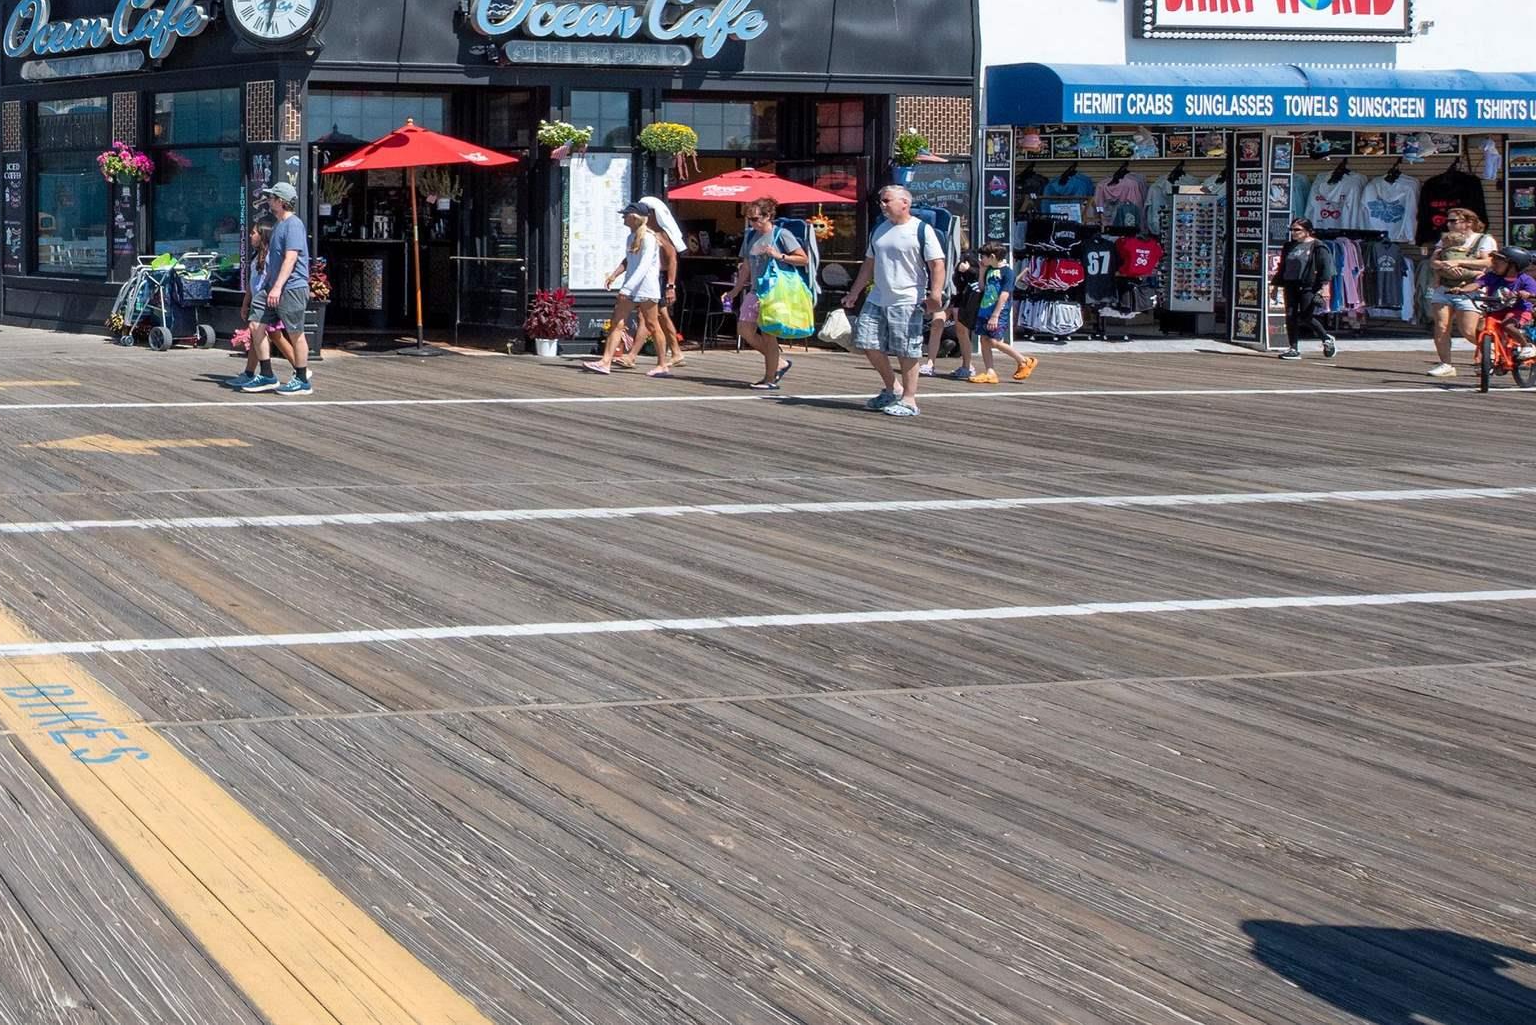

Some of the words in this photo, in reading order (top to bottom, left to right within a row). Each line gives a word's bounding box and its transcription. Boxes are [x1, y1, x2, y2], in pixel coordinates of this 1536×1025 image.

[1074, 93, 1124, 114] HERMIT
[1127, 93, 1173, 115] CRABS
[1185, 94, 1273, 116] SUNGLASSES
[1284, 95, 1339, 117] TOWELS
[1348, 96, 1425, 118] SUNSCREEN
[1435, 98, 1468, 119] HATS
[1475, 98, 1527, 120] TSHIRTS
[1087, 251, 1111, 275] 67
[1, 685, 150, 765] BIKES
